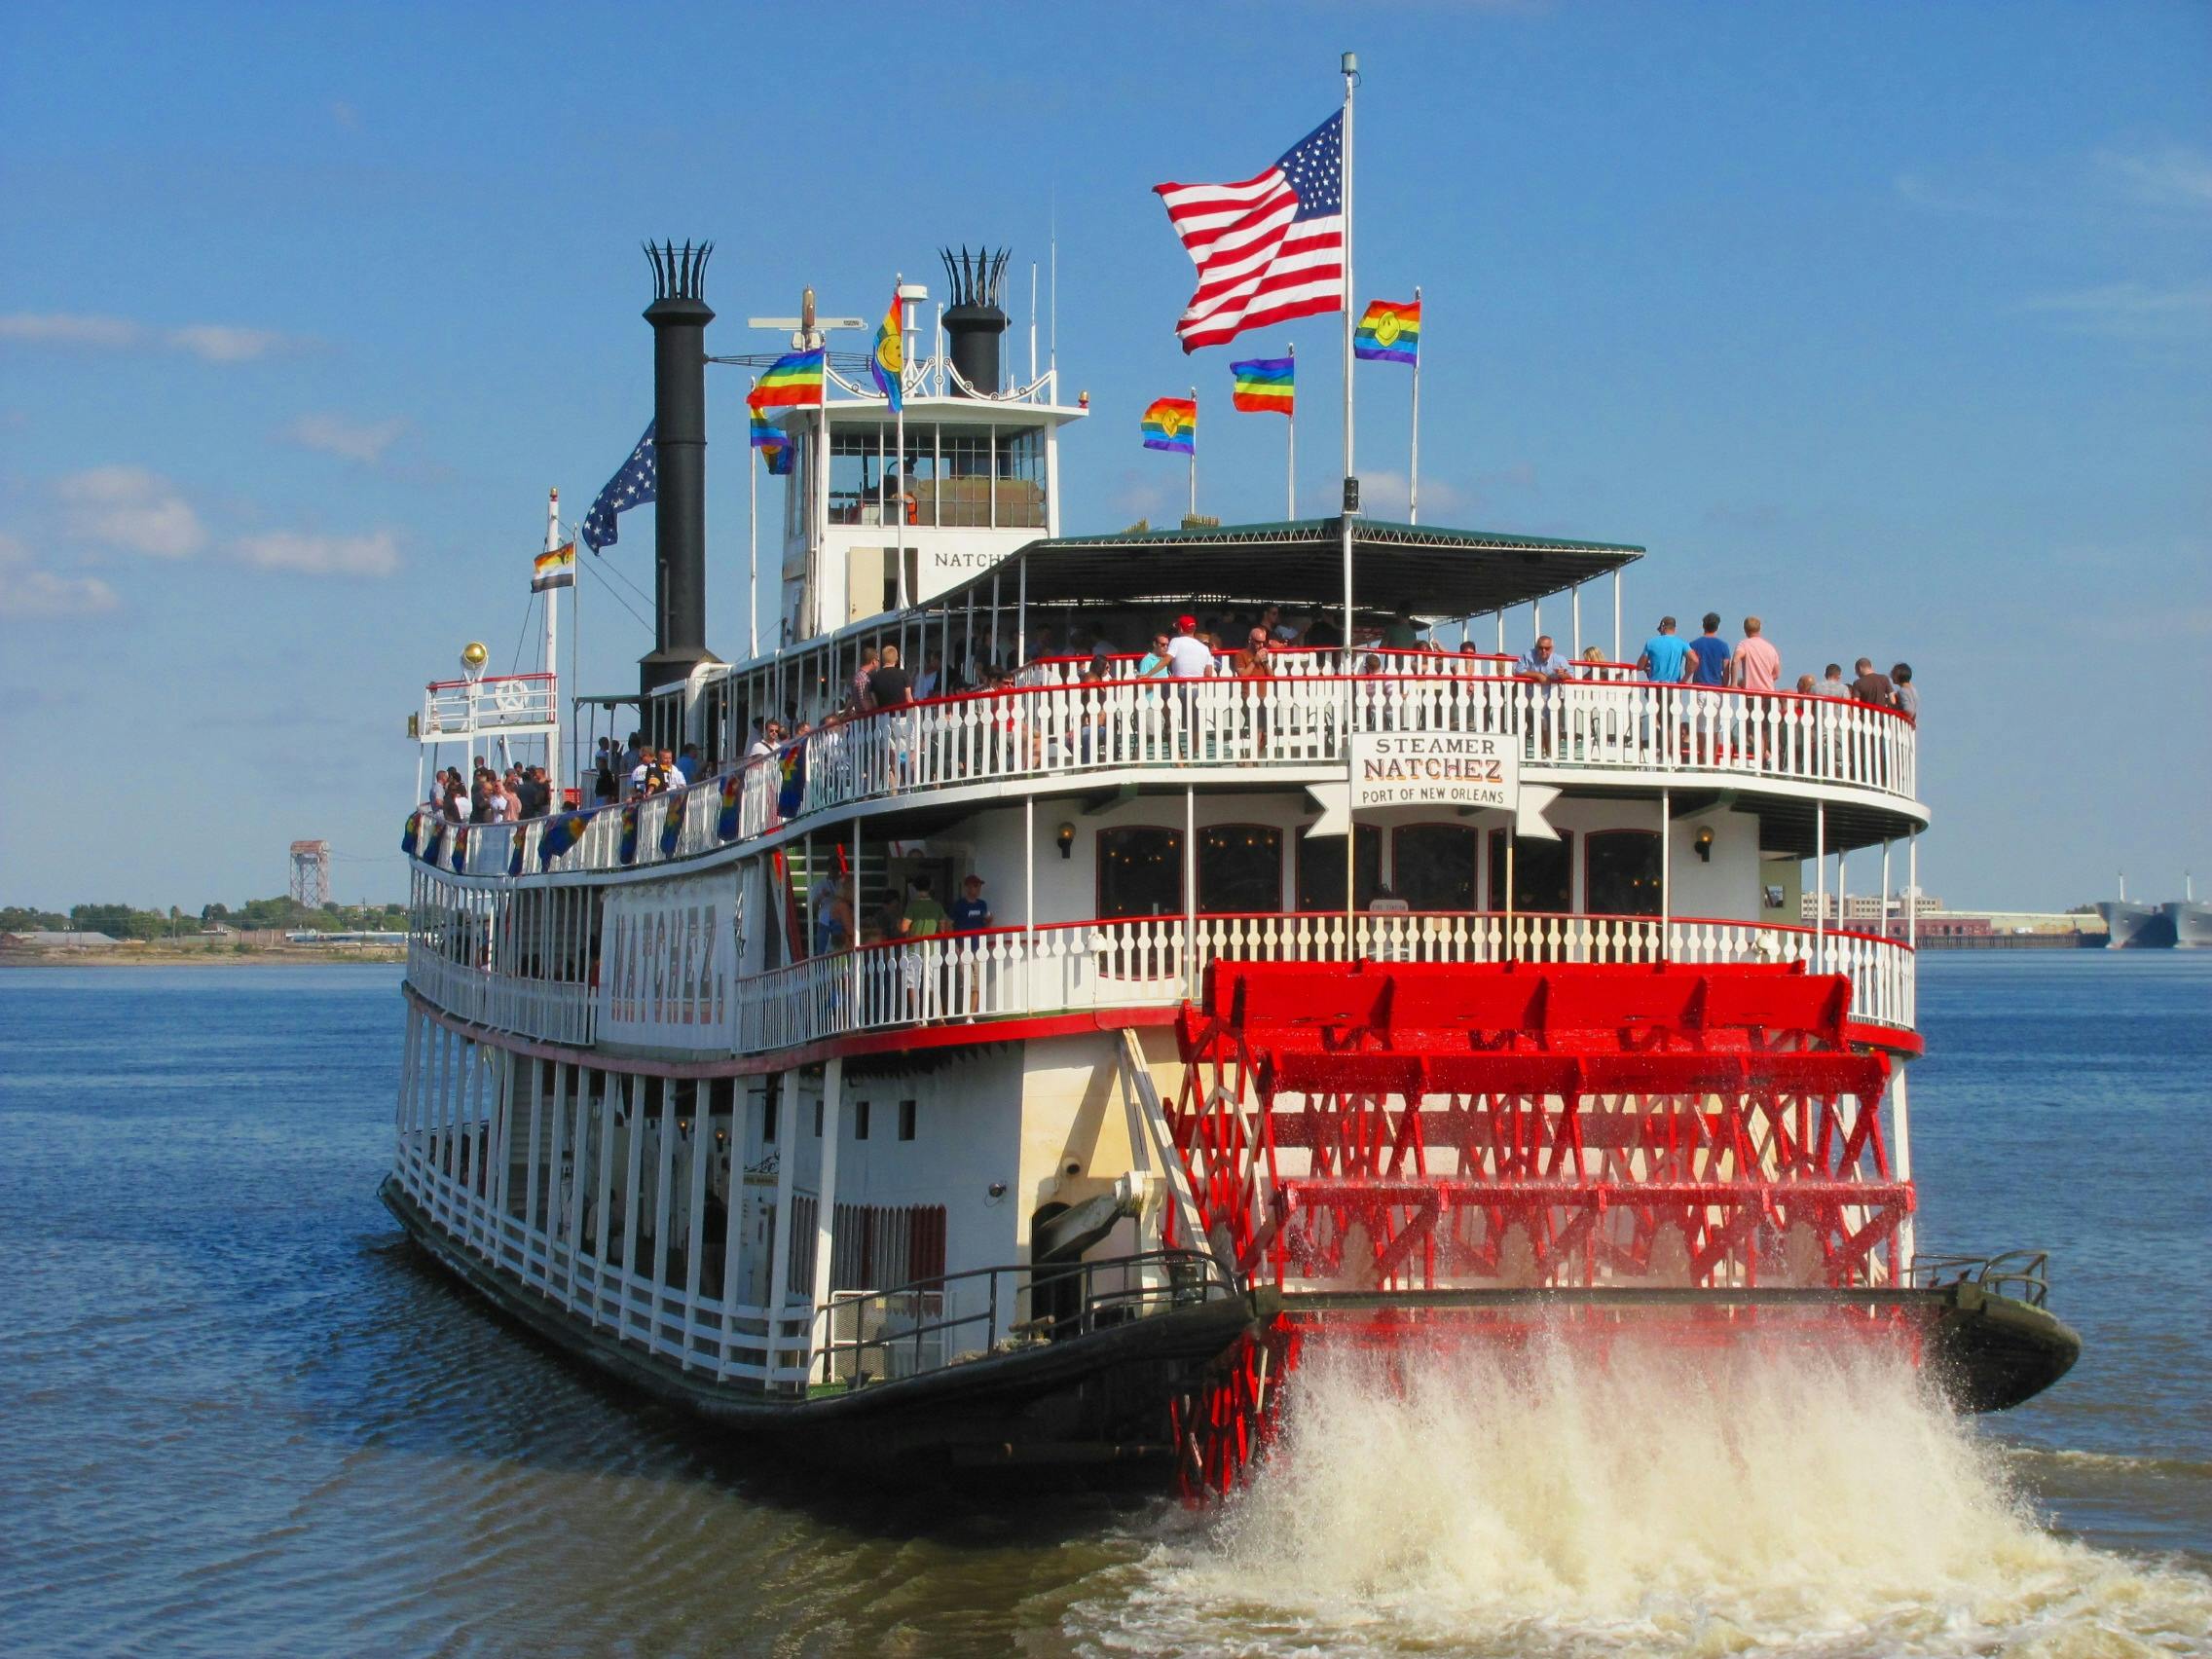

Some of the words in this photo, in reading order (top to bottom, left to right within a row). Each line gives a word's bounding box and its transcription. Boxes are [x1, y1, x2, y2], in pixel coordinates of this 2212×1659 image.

[1376, 738, 1495, 755] STEAMER
[1364, 758, 1502, 783] NATCHEZ
[1363, 789, 1393, 803] PORT
[1400, 788, 1415, 799] OF
[1420, 787, 1446, 799] NEW
[1451, 788, 1504, 804] ORLEANS
